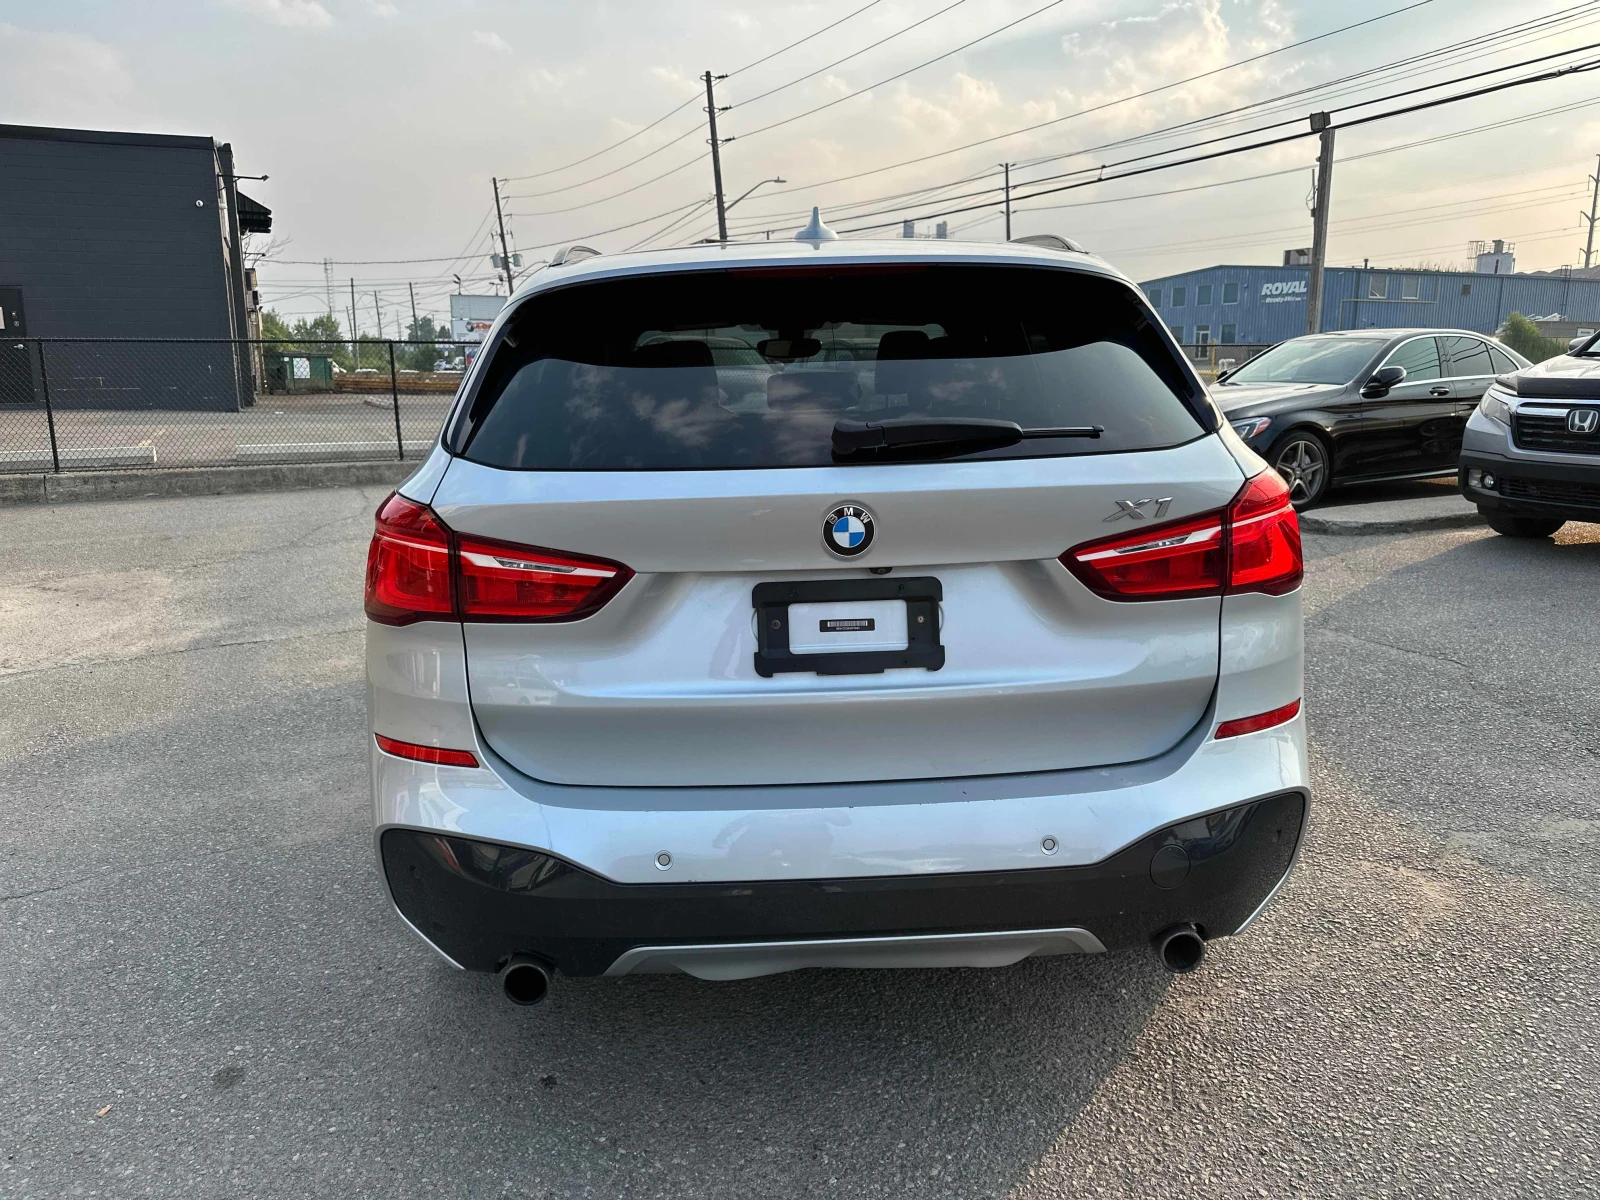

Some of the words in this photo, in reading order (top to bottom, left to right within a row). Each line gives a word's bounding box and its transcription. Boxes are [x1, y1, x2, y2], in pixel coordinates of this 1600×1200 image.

[1261, 281, 1307, 295] ROYAL
[827, 507, 871, 525] BMW
[1102, 497, 1174, 522] X1
